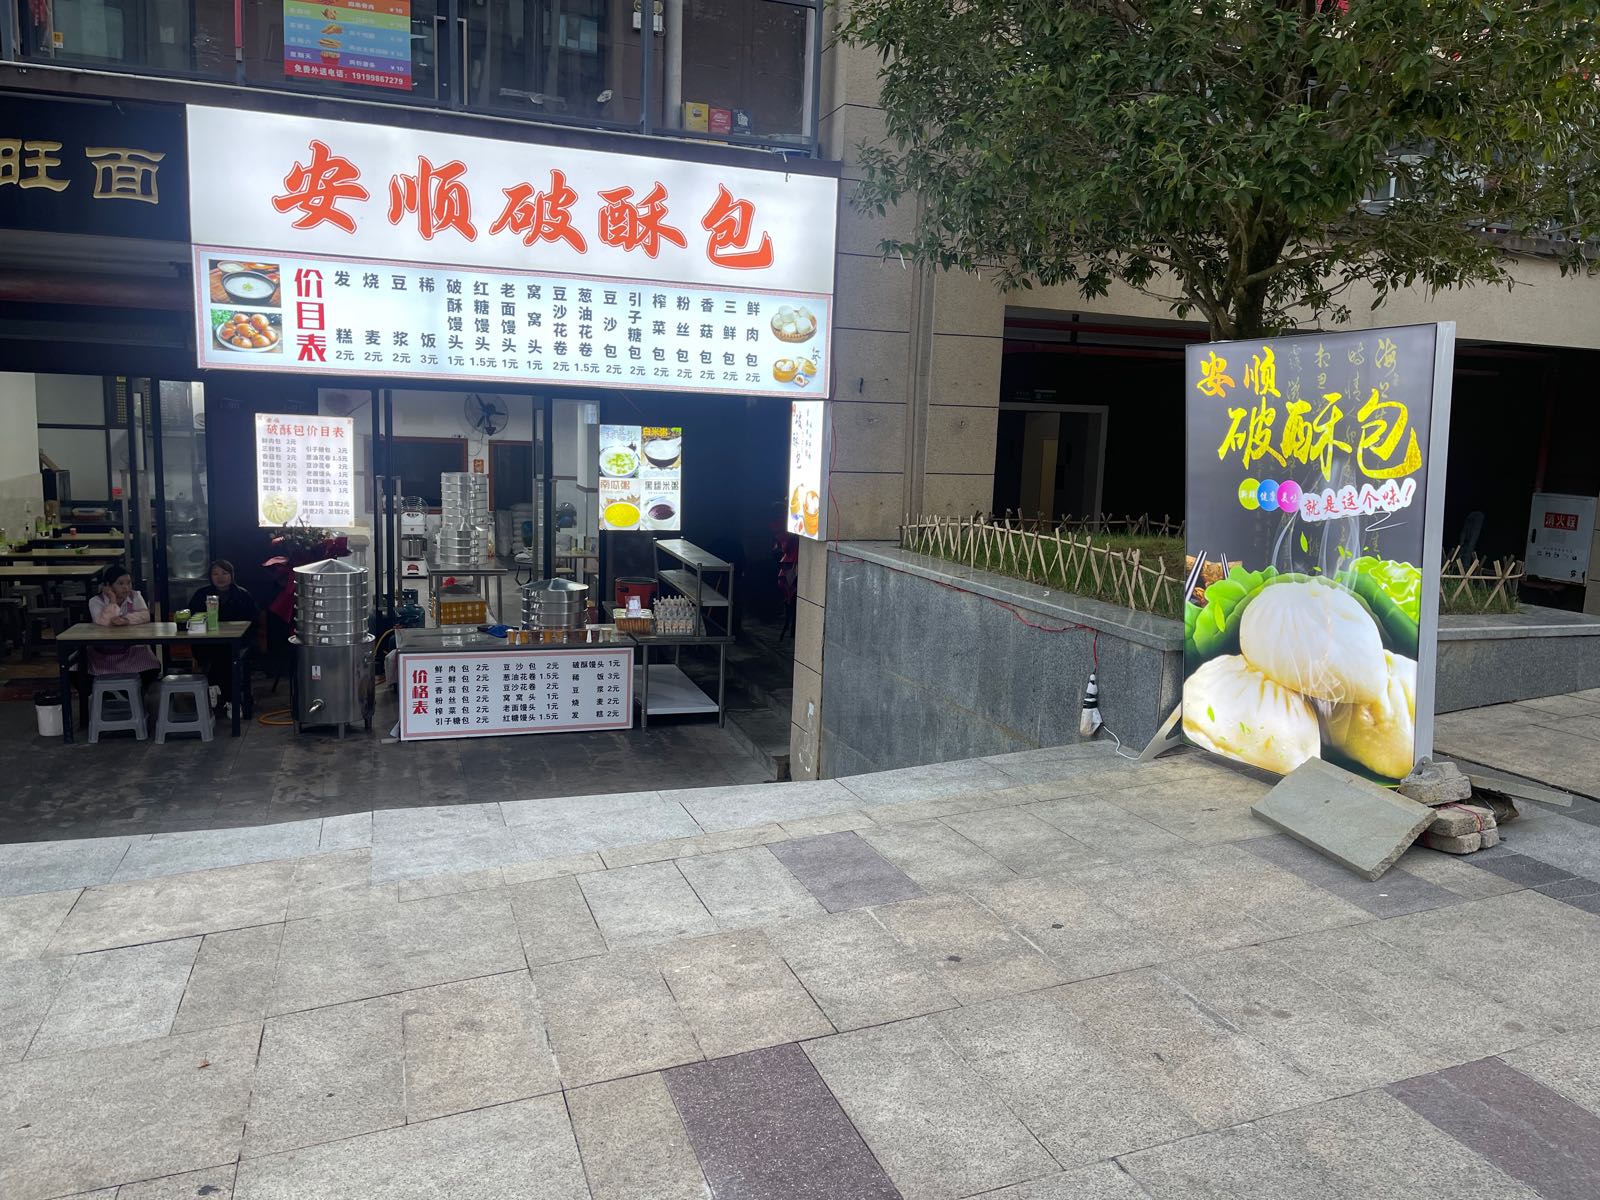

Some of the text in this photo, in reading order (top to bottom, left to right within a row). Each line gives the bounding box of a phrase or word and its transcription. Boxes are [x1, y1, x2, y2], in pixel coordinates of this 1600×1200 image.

[272, 139, 774, 269] 安顺破酥包
[294, 268, 326, 362] 价目表
[447, 279, 464, 366] 破酥馒头 1元
[470, 281, 497, 368] 红糖馒头 1.5元
[500, 282, 518, 369] 老面馒头 1元
[527, 285, 543, 370] 窝窝头 1元
[553, 287, 569, 372] 豆沙花卷 2元
[574, 289, 600, 373] 葱油花卷 1.5元
[603, 291, 622, 374] 豆沙包 2元
[628, 292, 645, 376] 引子糖包 2元
[652, 293, 669, 378] 榨菜包 2元
[676, 296, 693, 379] 粉丝包 2元
[700, 298, 715, 380] 香菇包 2元
[723, 299, 738, 381] 三鲜包 2元
[746, 301, 760, 382] 鲜肉包 2元
[336, 350, 354, 361] 2元
[364, 352, 383, 362] 2元
[392, 353, 411, 363] 2元
[420, 354, 438, 364] 3元
[1196, 345, 1281, 399] 安顺
[266, 424, 344, 438] 破酥包价目表
[1218, 388, 1423, 482] 破酥包
[1304, 485, 1412, 516] 就是这个味！
[435, 665, 469, 674] 鲜肉包
[435, 675, 469, 684] 三鲜包
[503, 662, 559, 671] 豆沙包 2元
[503, 672, 559, 681] 葱油花卷 1.5元
[572, 661, 604, 669] 破酥馒头
[608, 672, 620, 680] 3元
[412, 670, 428, 714] 价格表
[435, 685, 469, 694] 香菇包
[435, 696, 469, 704] 粉丝包
[503, 683, 536, 691] 豆沙花卷
[503, 693, 536, 701] 窝窝头
[435, 706, 469, 715] 榨菜包
[435, 716, 489, 726] 引子糖包 2元
[503, 714, 536, 722] 红糖馒头
